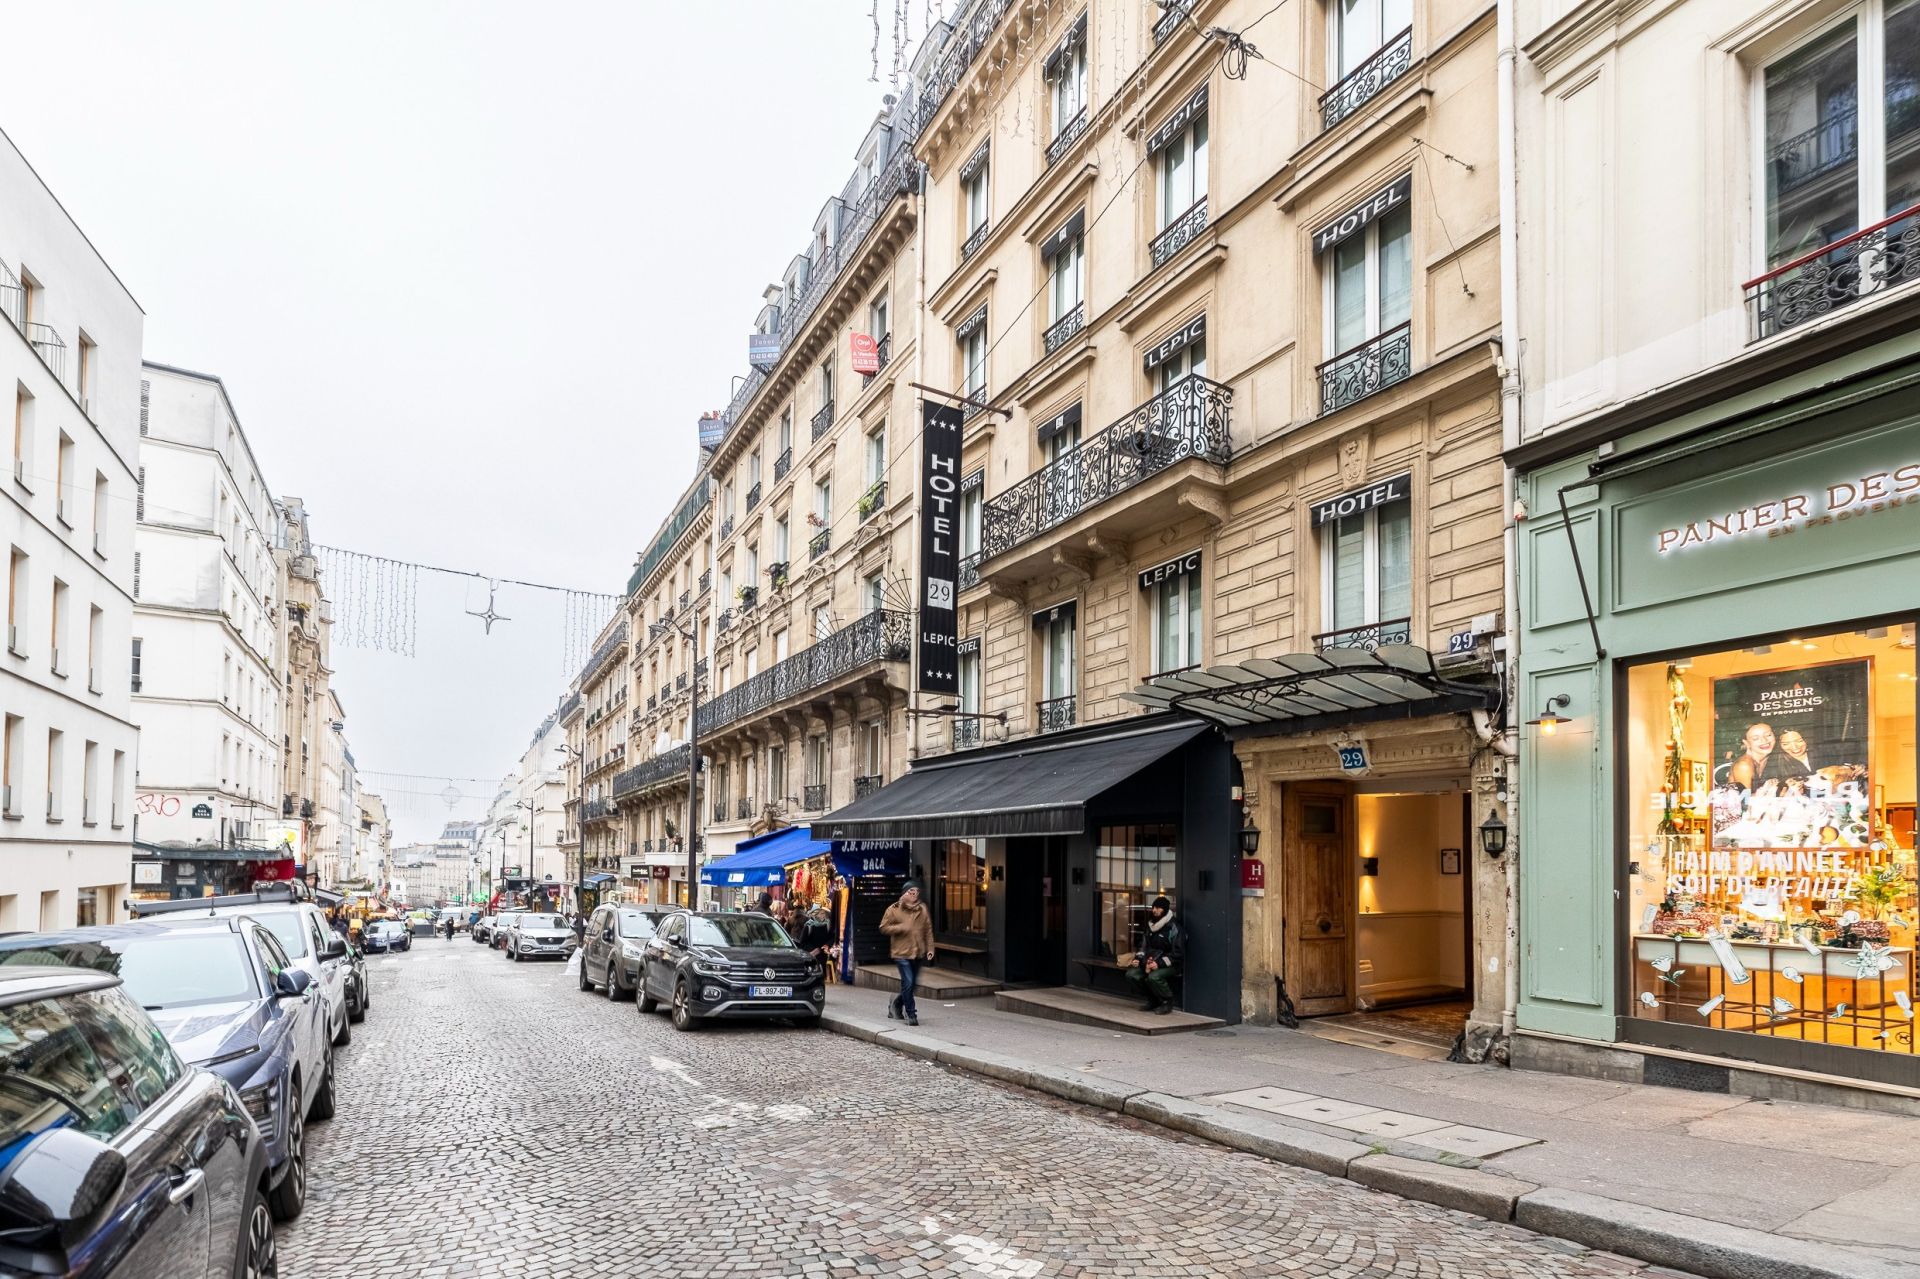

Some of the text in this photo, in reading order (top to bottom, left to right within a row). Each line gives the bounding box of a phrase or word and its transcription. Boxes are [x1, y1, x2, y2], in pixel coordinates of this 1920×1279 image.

[1150, 91, 1206, 152] LEPIC
[961, 144, 989, 180] HOTEL
[1321, 188, 1402, 249] HOTEL
[958, 307, 987, 339] HOTEL
[1149, 325, 1204, 366] LEPIC
[961, 473, 982, 491] OTEL
[928, 454, 955, 556] HOTEL
[1319, 482, 1401, 523] HOTEL
[1657, 464, 1920, 554] PANIER DES
[1767, 524, 1795, 539] EN
[1143, 555, 1198, 588] LEPIC
[929, 583, 951, 602] 29
[923, 632, 956, 647] LEPIC
[957, 640, 978, 654] OTEL
[1451, 633, 1474, 652] 29
[1761, 687, 1814, 700] PANIER
[1753, 696, 1823, 712] DES SENS
[1773, 708, 1814, 716] PROVENCE
[1342, 752, 1364, 767] 29
[861, 840, 904, 851] DIFFUSION
[863, 858, 885, 871] BALA
[1251, 864, 1262, 876] H
[1675, 851, 1730, 872] FAIM
[1670, 874, 1721, 895] SOIF
[1728, 875, 1755, 896] DE
